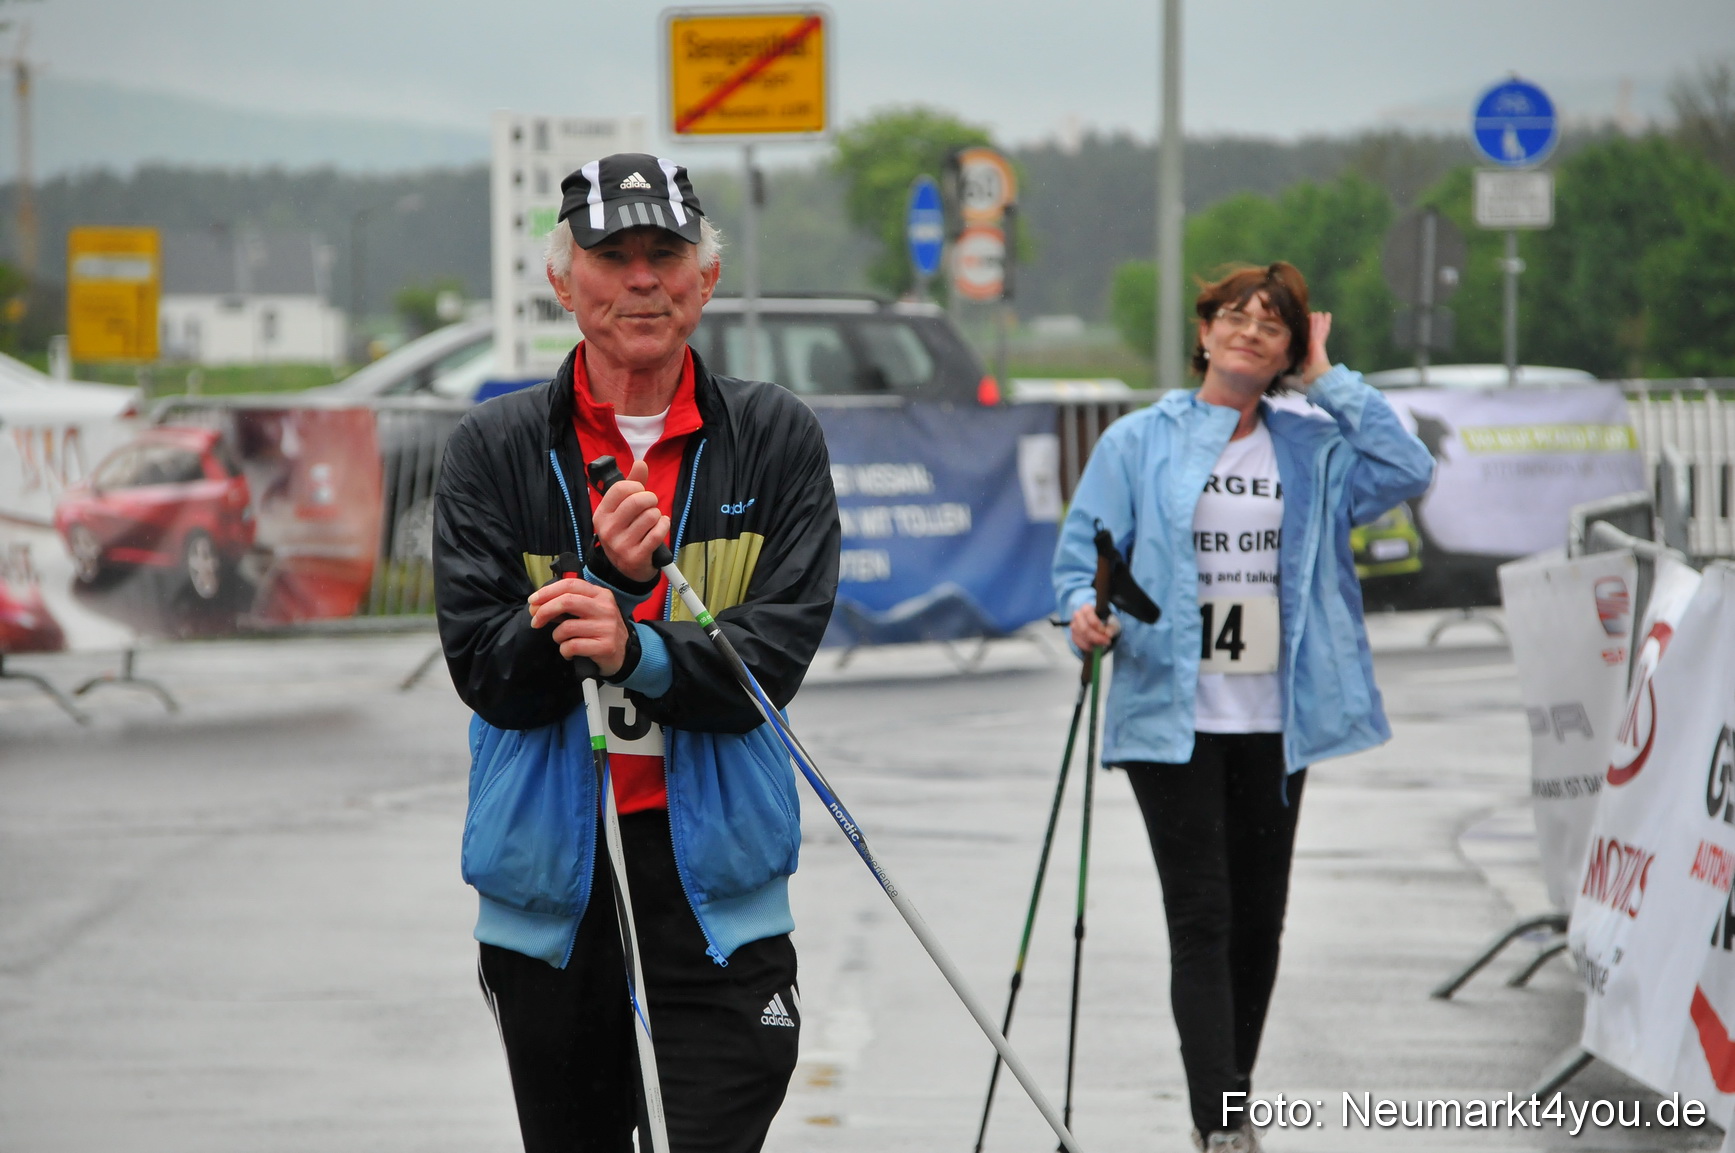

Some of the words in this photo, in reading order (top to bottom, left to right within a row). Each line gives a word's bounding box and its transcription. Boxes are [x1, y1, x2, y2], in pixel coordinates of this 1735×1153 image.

[620, 181, 651, 189] adidas
[1218, 570, 1241, 582] and
[1200, 603, 1246, 662] 14
[829, 802, 860, 842] nordic
[760, 1014, 795, 1028] adidas
